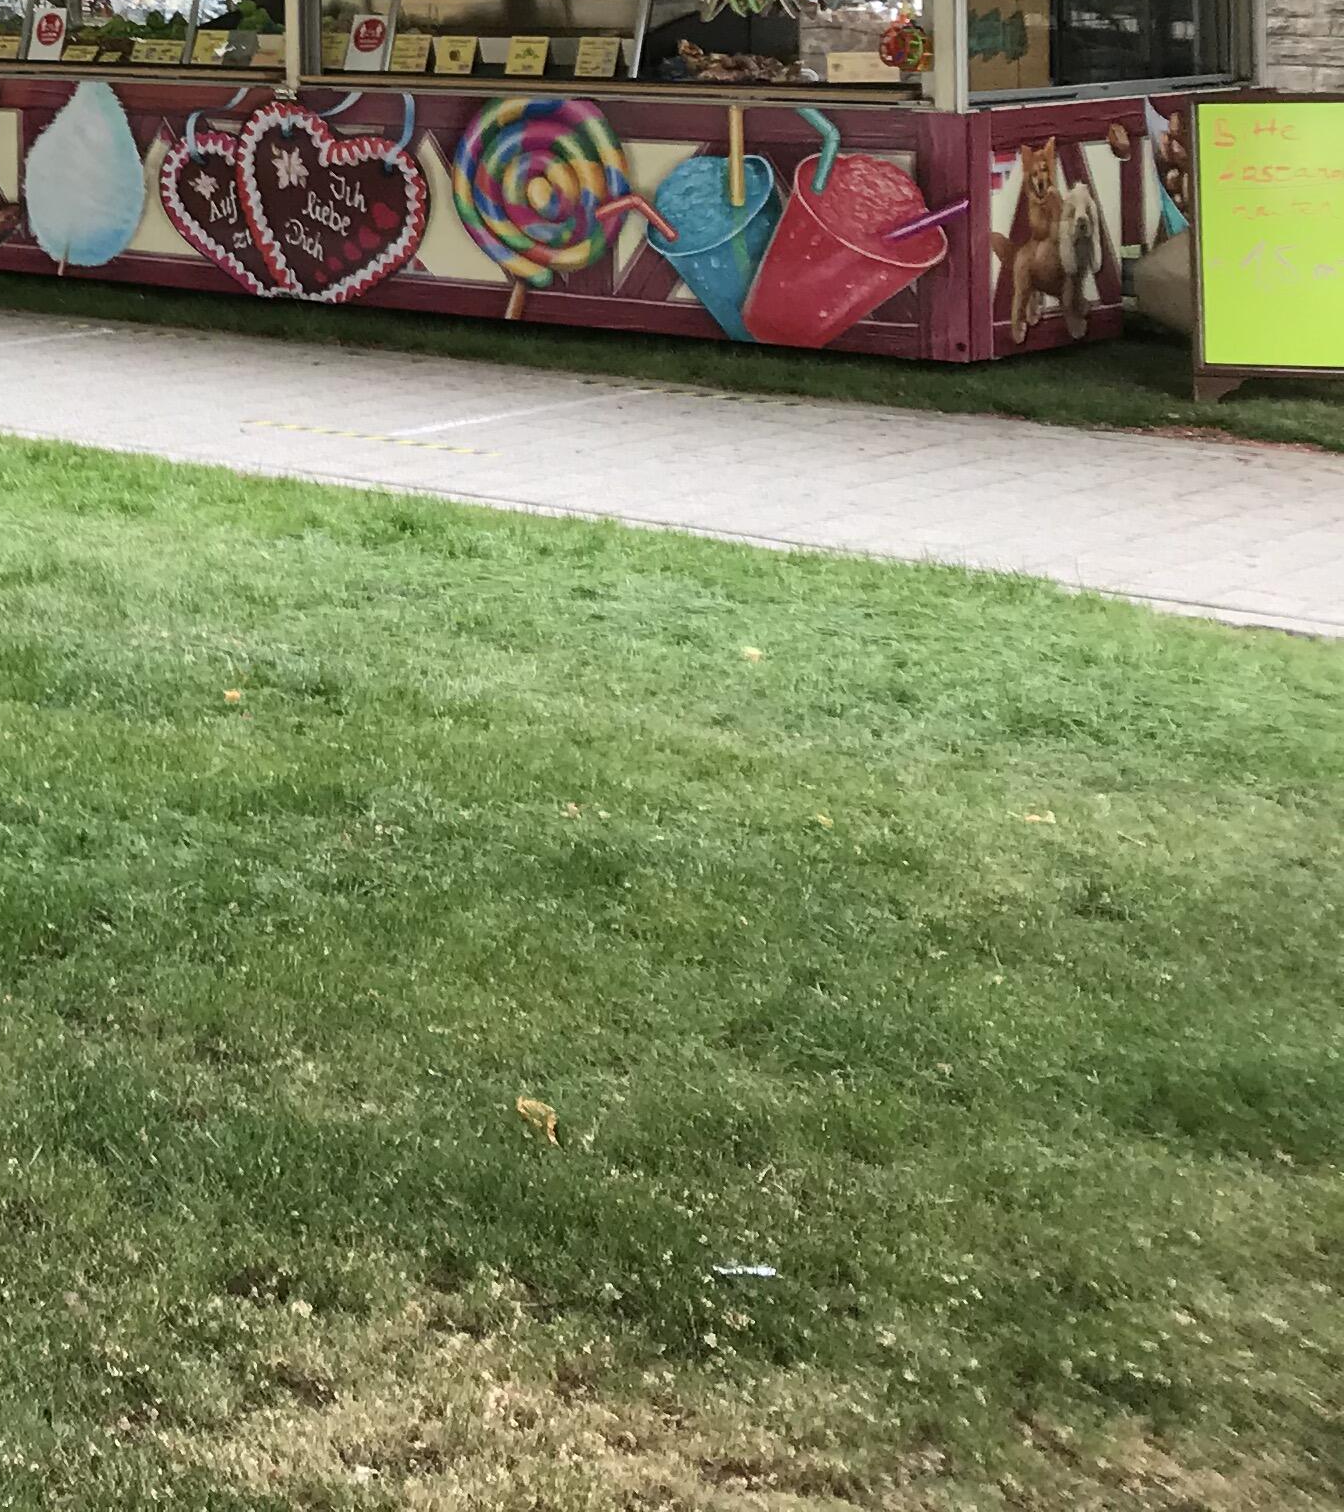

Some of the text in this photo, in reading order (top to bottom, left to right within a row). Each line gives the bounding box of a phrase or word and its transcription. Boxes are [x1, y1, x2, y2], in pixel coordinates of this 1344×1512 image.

[209, 181, 238, 224] Auf
[301, 191, 351, 236] liebe
[329, 171, 367, 213] Ich
[284, 218, 324, 262] Dich
